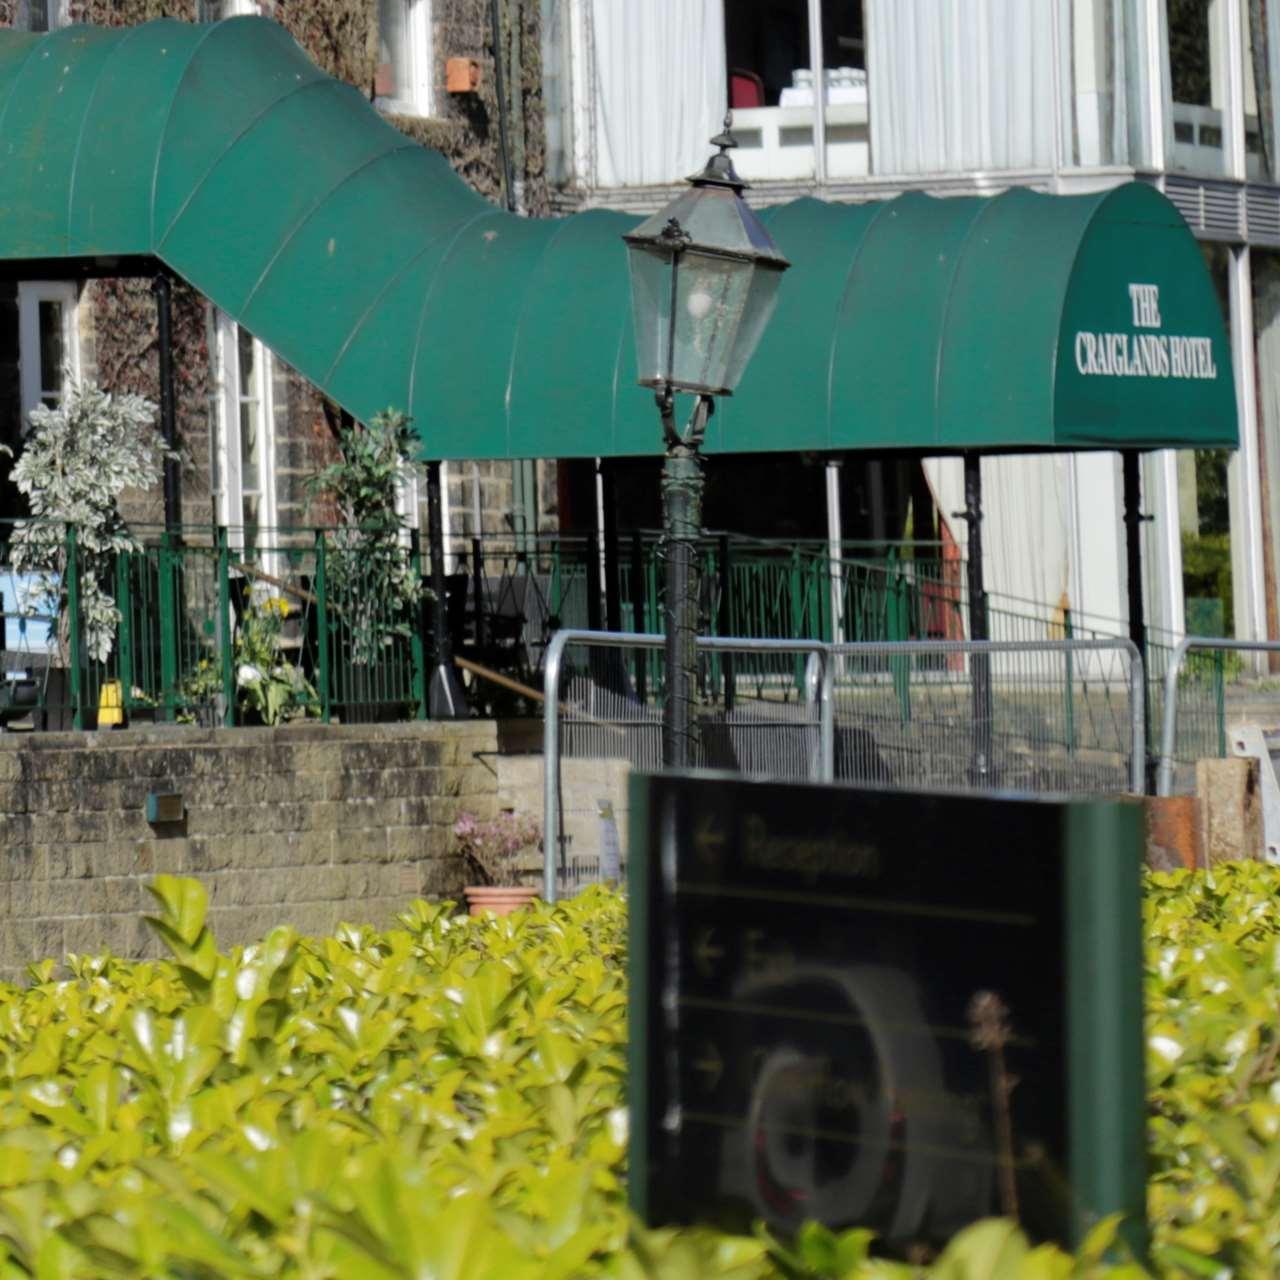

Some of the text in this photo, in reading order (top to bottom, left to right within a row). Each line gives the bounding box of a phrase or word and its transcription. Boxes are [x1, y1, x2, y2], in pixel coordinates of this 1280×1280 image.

[1129, 283, 1161, 328] THE
[1075, 331, 1216, 379] CRAIGLANDS HOTEL
